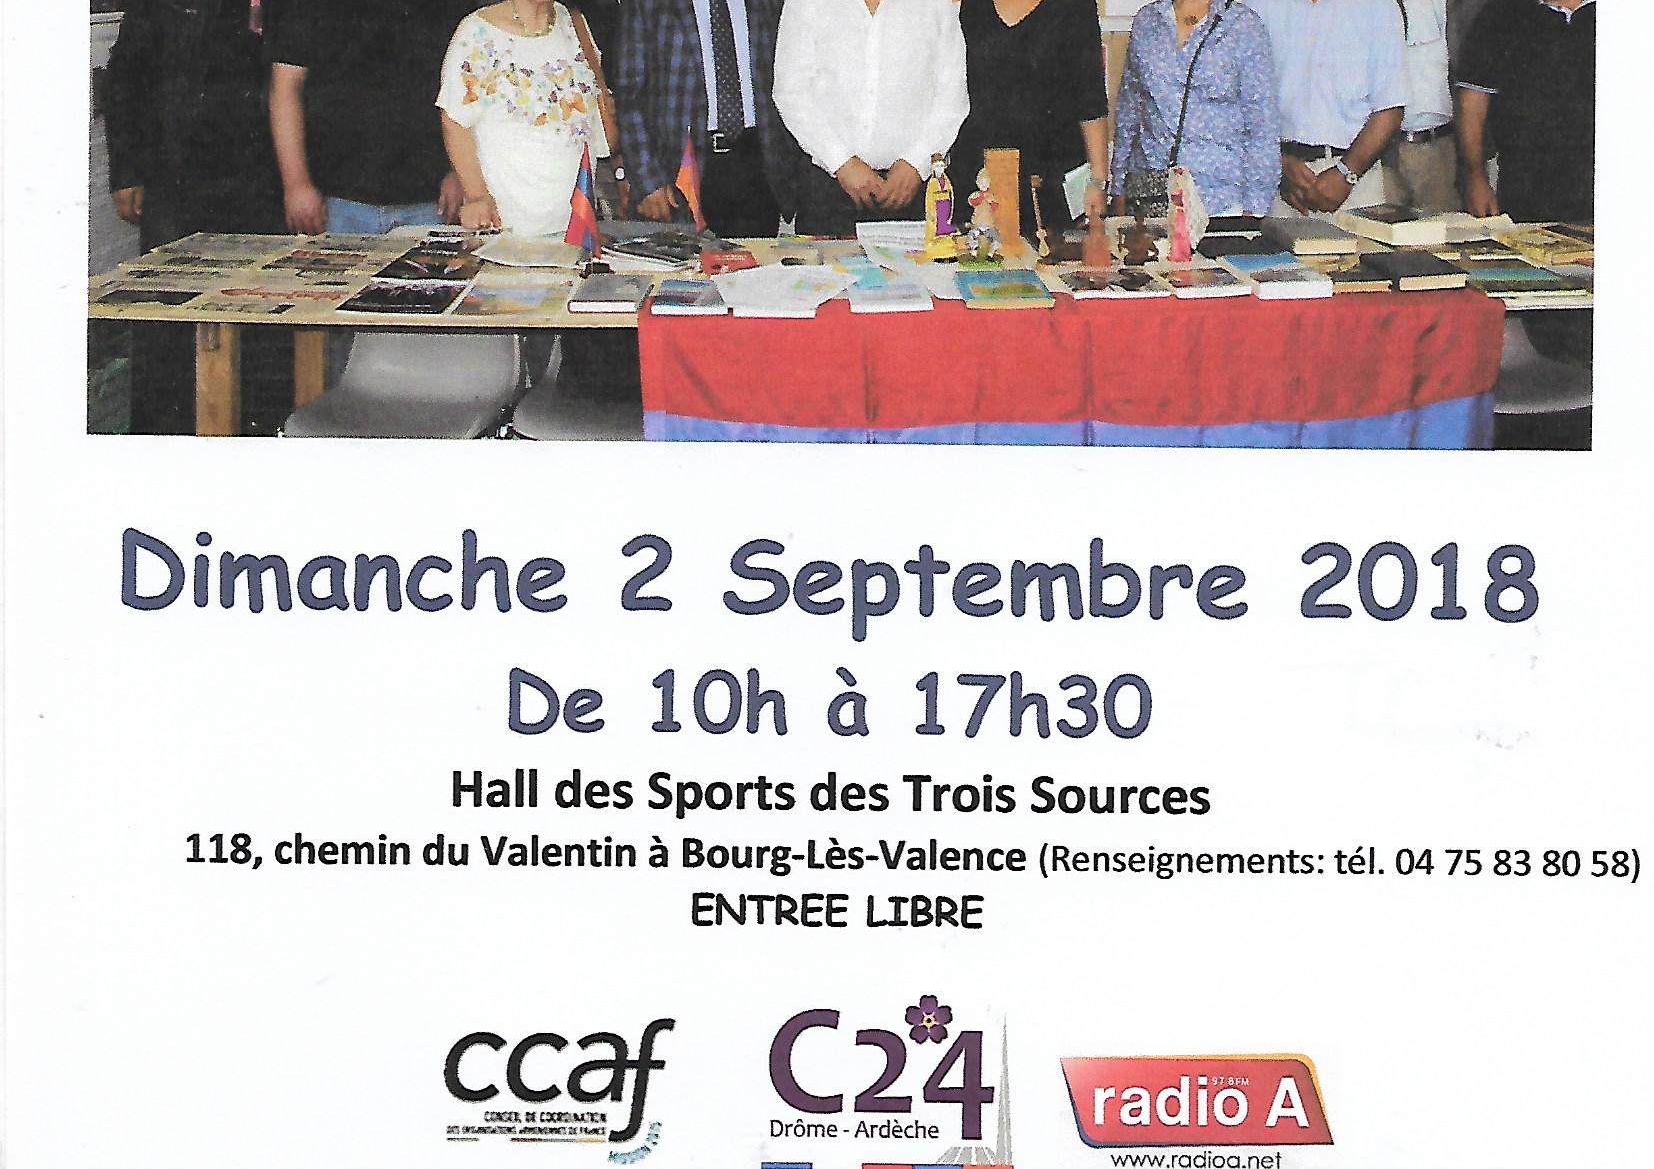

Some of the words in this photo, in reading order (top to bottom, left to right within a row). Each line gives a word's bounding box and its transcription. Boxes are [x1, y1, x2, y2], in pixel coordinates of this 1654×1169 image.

[121, 527, 568, 613] Dimanche
[621, 534, 672, 611] 2
[723, 538, 1248, 642] Septembre
[1301, 541, 1539, 623] 2018
[508, 667, 605, 735] De
[652, 668, 787, 736] 10h
[828, 667, 869, 736] à
[916, 671, 1152, 739] 17h30
[453, 768, 537, 807] Hall
[555, 769, 633, 809] des
[648, 772, 796, 819] Sports
[810, 772, 889, 811] des
[903, 774, 1016, 813] Trois
[1031, 776, 1210, 815] Sources
[187, 833, 262, 869] 118,
[275, 832, 410, 865] chemin
[423, 834, 469, 866] du
[481, 835, 636, 867] Valentin
[649, 836, 668, 868] à
[683, 838, 1026, 876] Bourg-Lès-Valence
[1040, 843, 1323, 879] (Renseignements:
[1334, 846, 1384, 874] tél.
[1396, 848, 1434, 875] 04
[1445, 849, 1482, 875] 75
[1493, 850, 1531, 876] 83
[1543, 850, 1580, 877] 80
[1591, 849, 1640, 881] 58)
[692, 892, 849, 927] ENTREE
[867, 895, 984, 929] LIBRE
[443, 1018, 676, 1142] ccaf
[769, 1008, 995, 1140] C24
[1093, 1075, 1249, 1127] radio
[1265, 1076, 1310, 1128] A
[769, 1119, 837, 1138] Drôme
[855, 1119, 939, 1139] Ardèche
[1111, 1152, 1282, 1169] www.radioa.net
